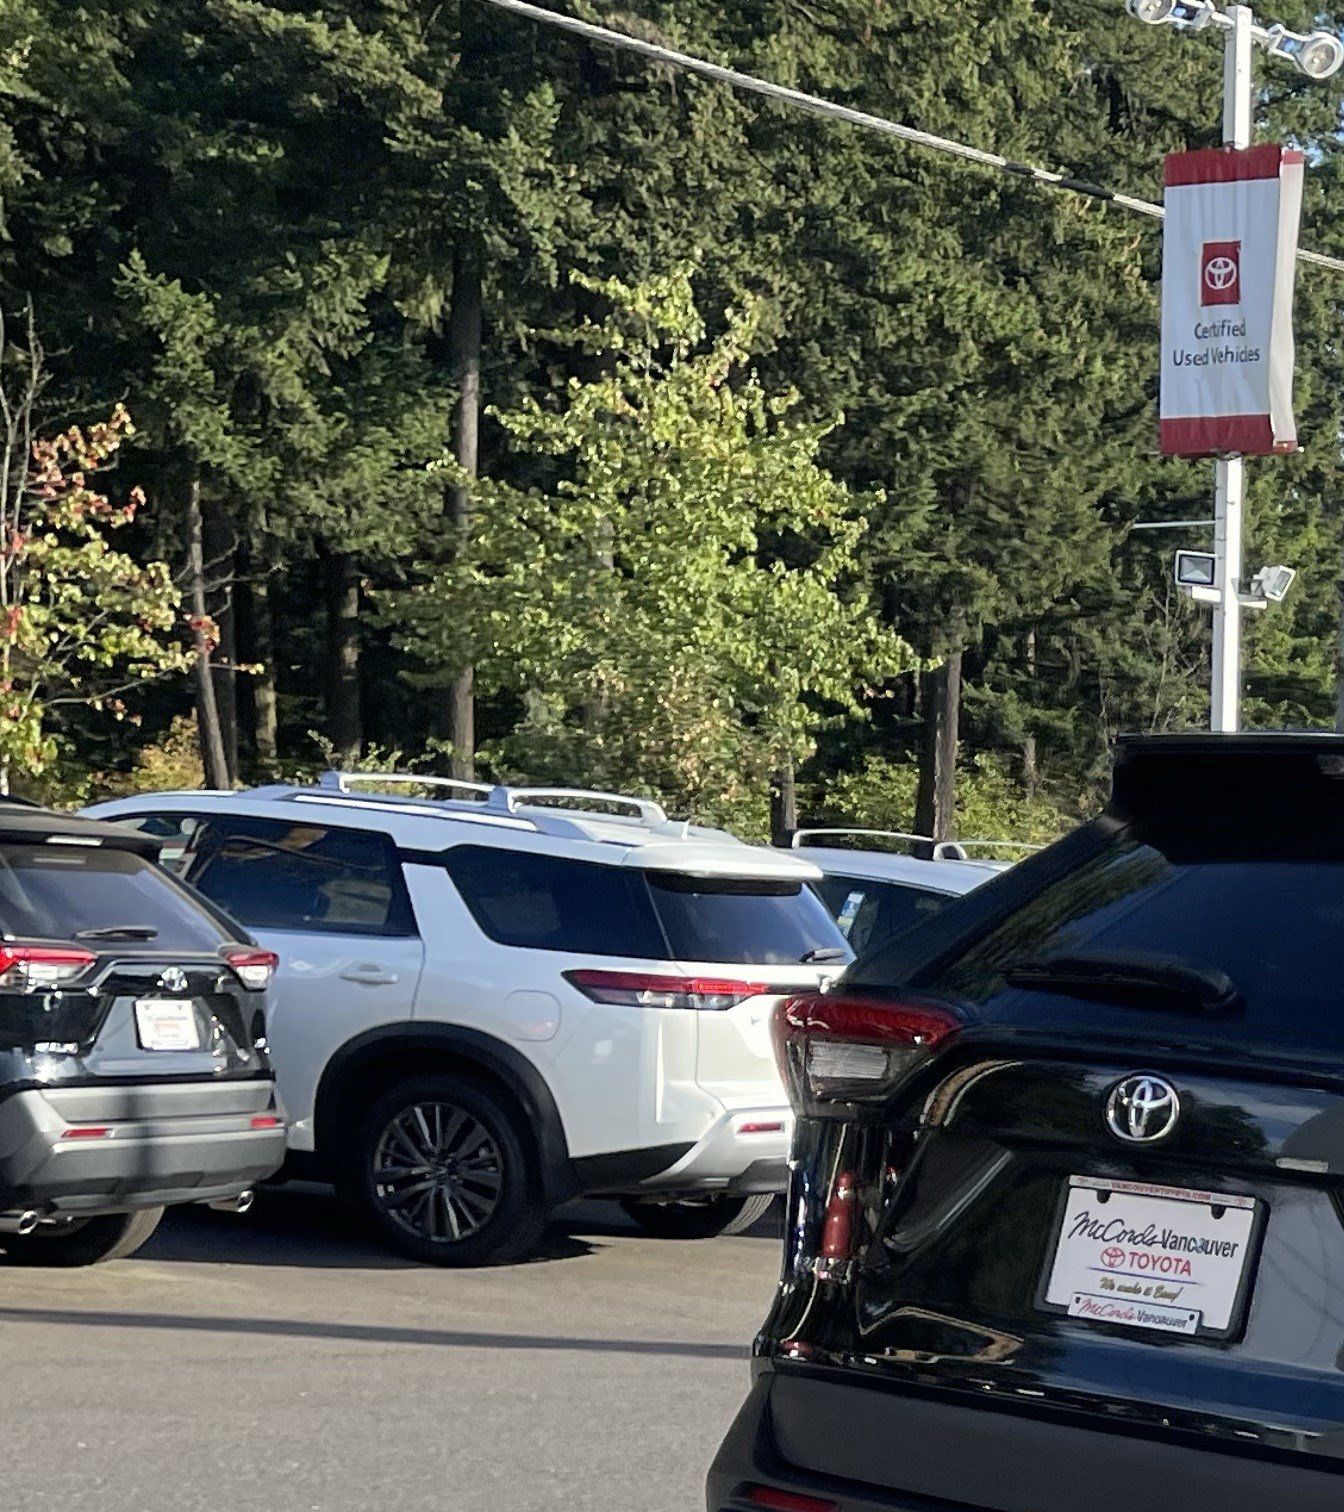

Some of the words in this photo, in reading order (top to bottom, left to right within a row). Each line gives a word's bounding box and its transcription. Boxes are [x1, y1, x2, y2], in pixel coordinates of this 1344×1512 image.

[1194, 318, 1246, 341] Certified
[1173, 348, 1209, 367] Used
[1211, 346, 1261, 365] Vehicles
[1161, 1228, 1239, 1258] Vancouver
[1129, 1251, 1192, 1277] TOYOTA
